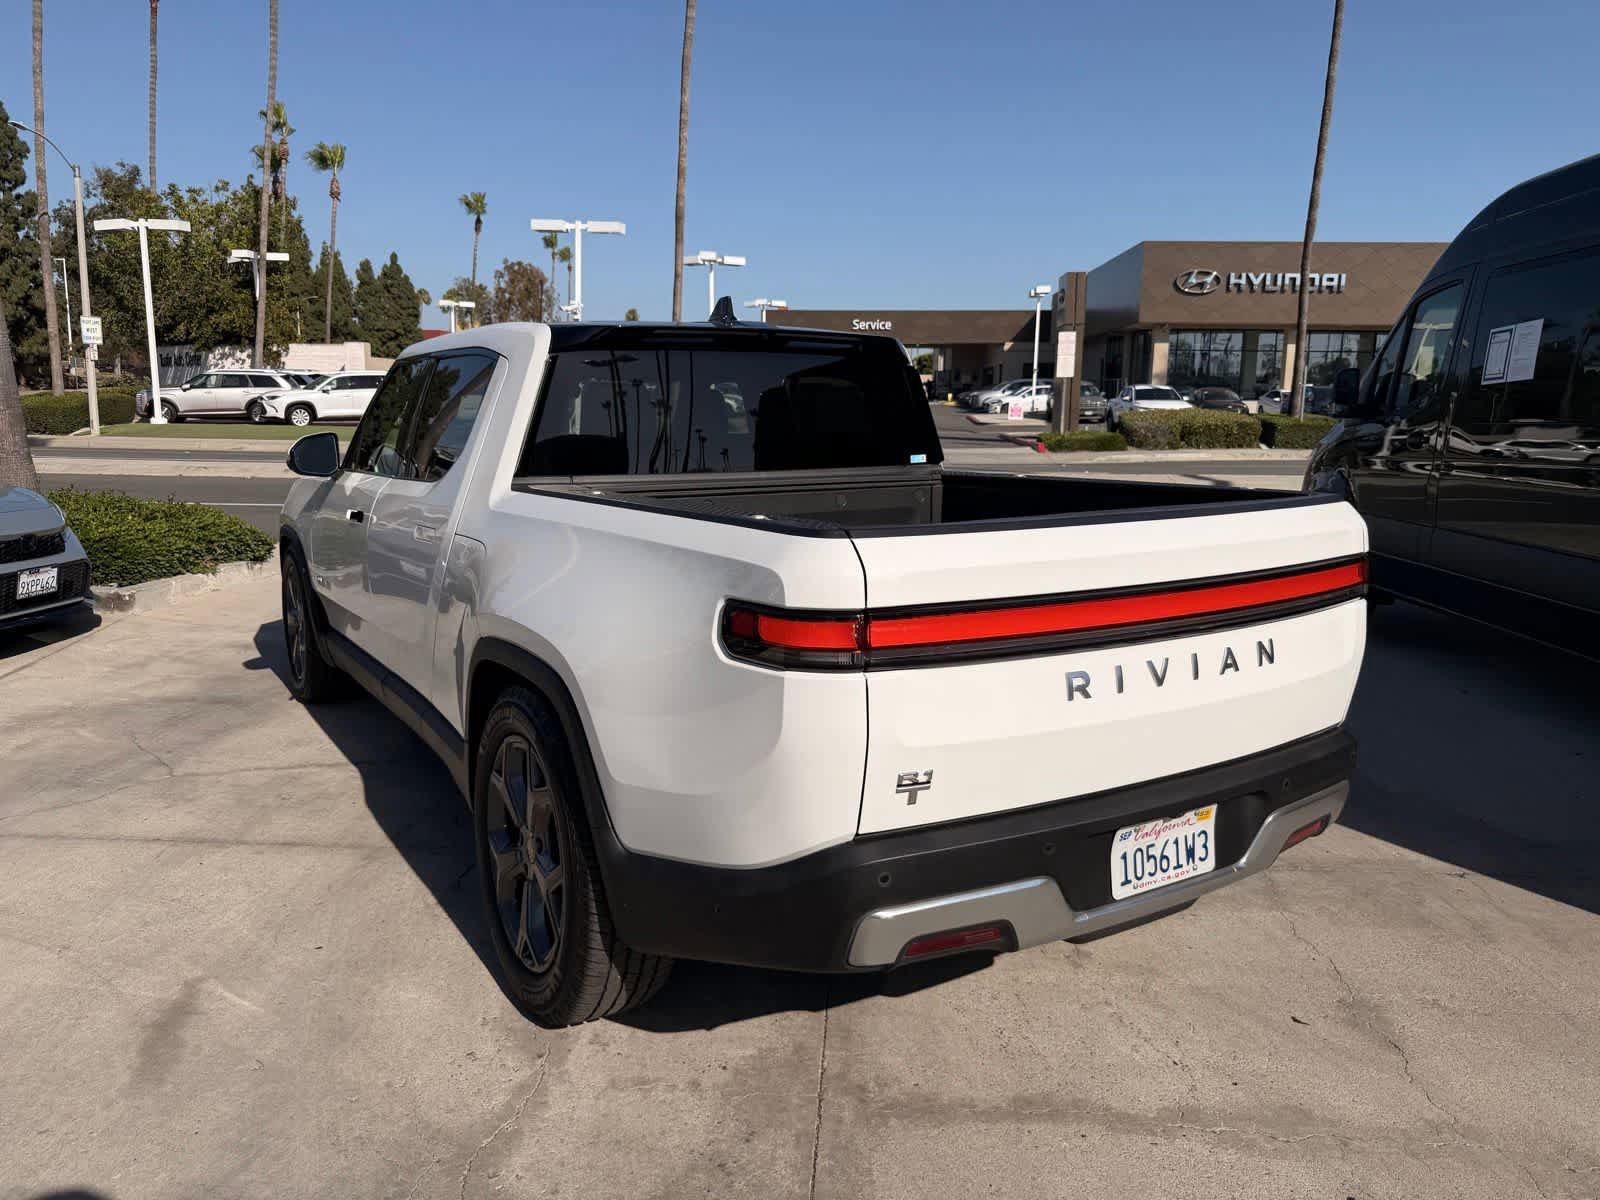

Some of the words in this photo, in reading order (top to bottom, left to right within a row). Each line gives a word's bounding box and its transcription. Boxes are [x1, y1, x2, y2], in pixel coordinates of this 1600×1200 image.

[1227, 272, 1347, 292] HYUNDAI
[852, 319, 892, 330] Service
[1065, 638, 1275, 701] RIVIAN
[1134, 817, 1196, 841] California
[1120, 829, 1209, 887] 10561W3
[1139, 869, 1191, 889] dmv.ca.gov
